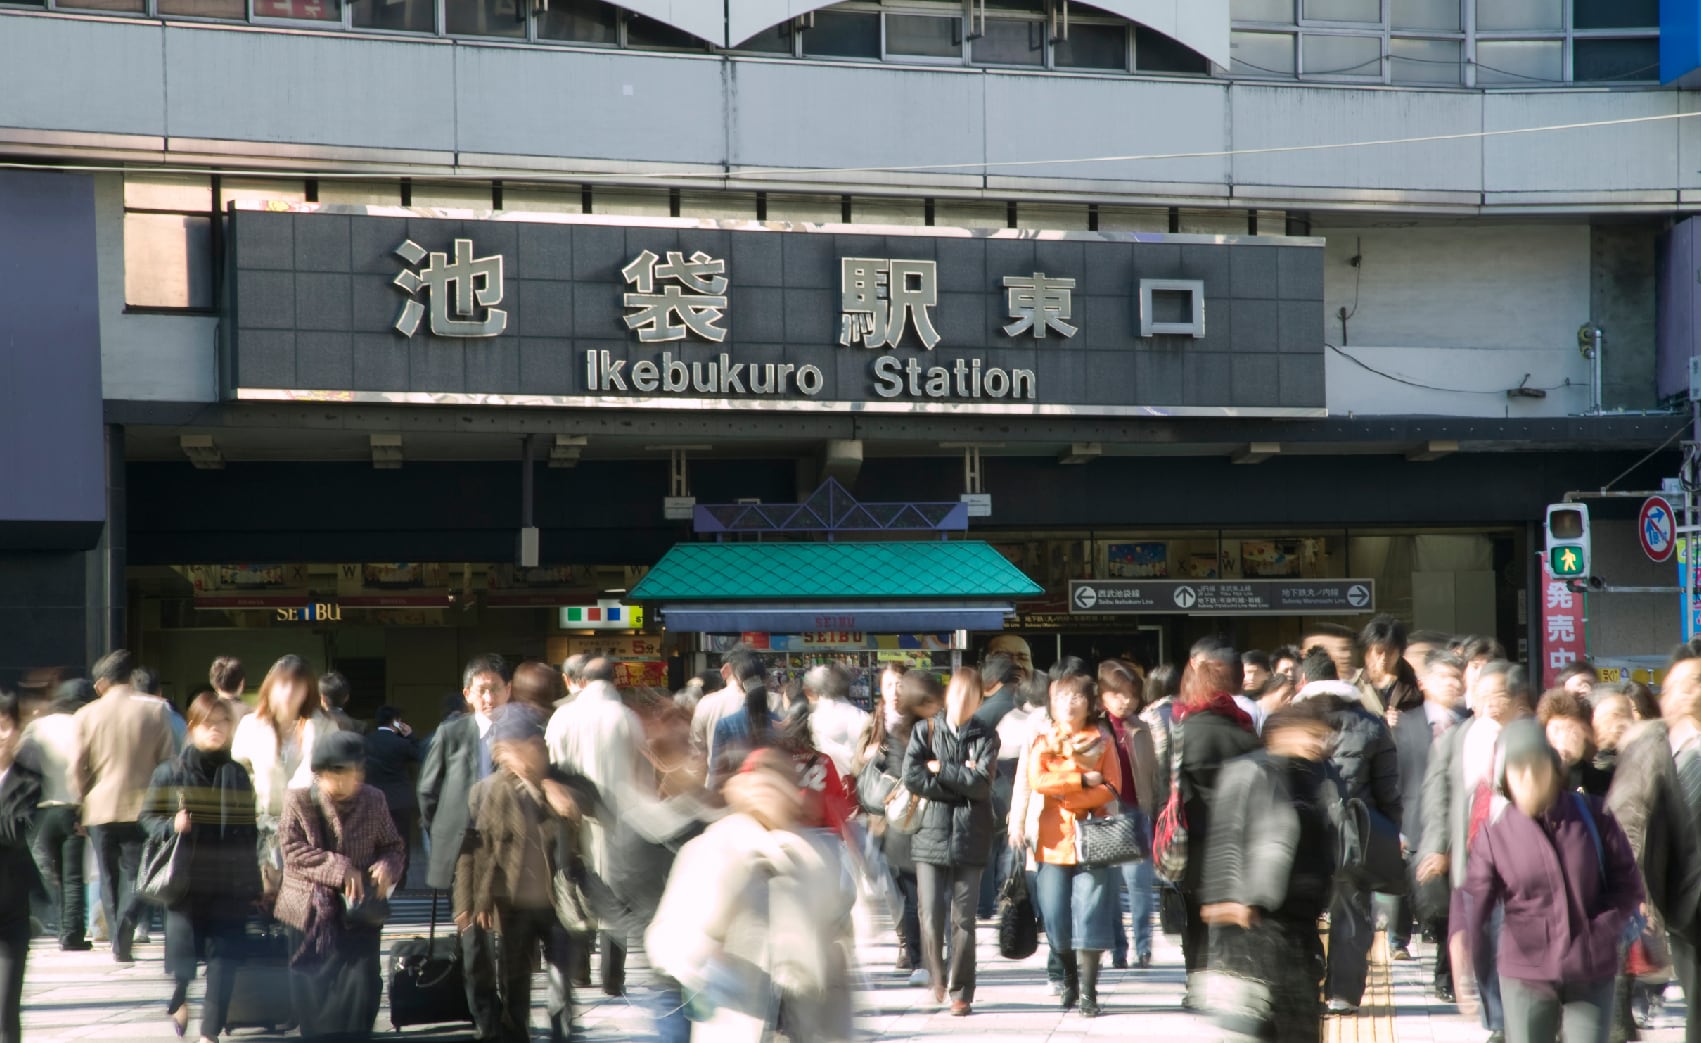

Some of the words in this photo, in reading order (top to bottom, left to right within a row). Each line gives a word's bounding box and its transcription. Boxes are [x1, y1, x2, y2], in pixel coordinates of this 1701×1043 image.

[393, 237, 1207, 350] 池袋駅東口
[585, 349, 824, 396] Ikebukuro
[873, 355, 1037, 400] Station
[803, 631, 863, 643] SEIBU
[815, 615, 856, 629] SEIBU
[1544, 560, 1577, 670] 発売中
